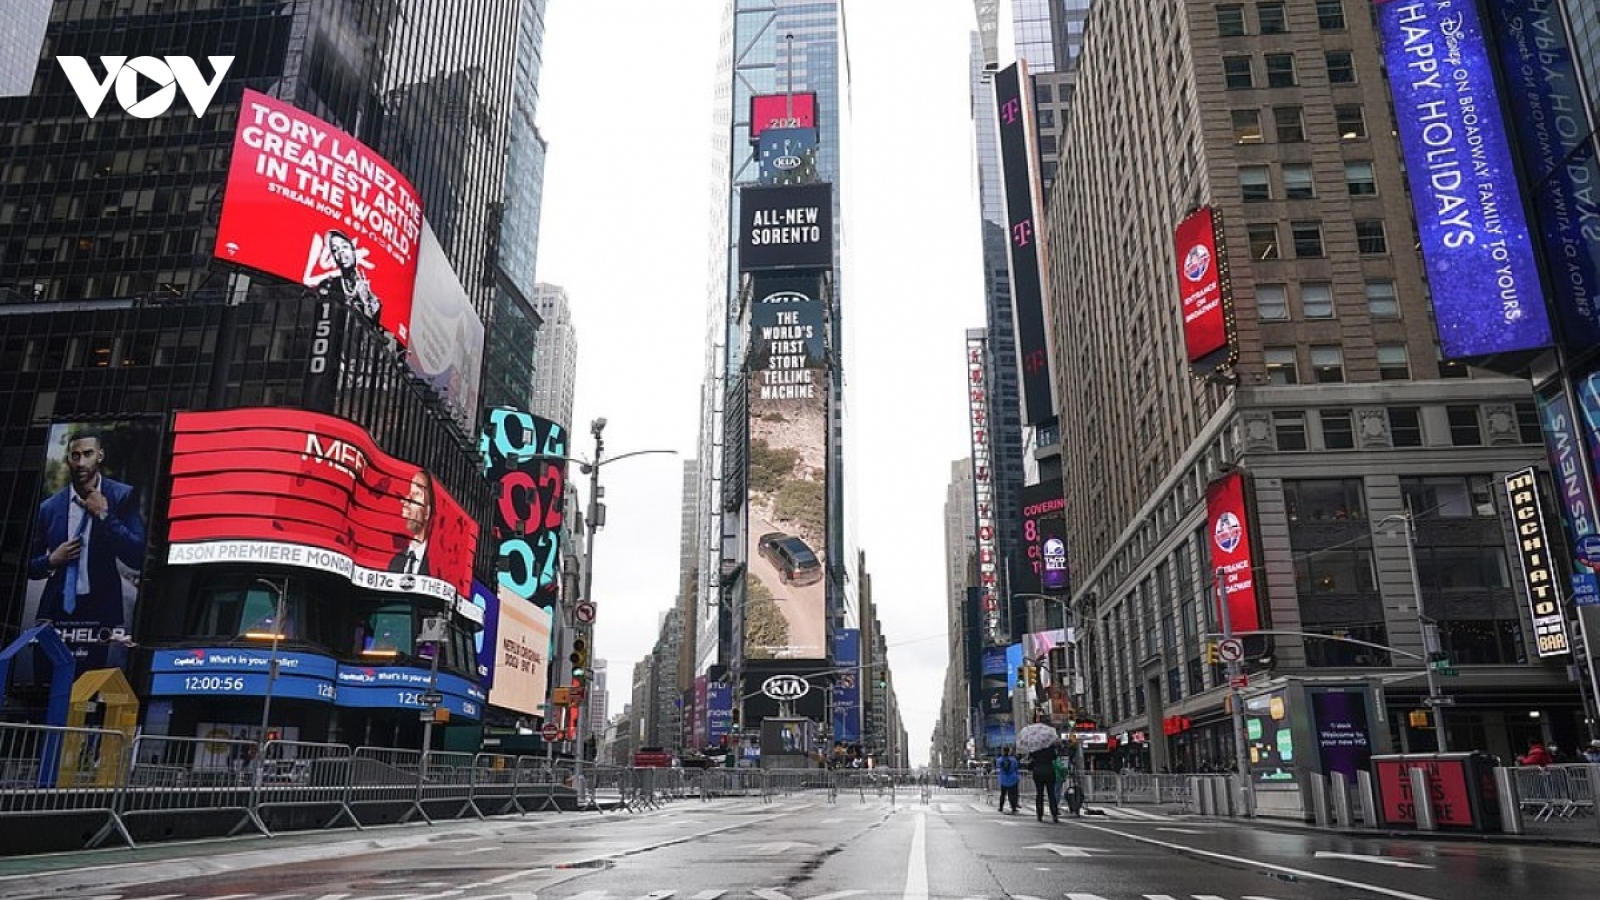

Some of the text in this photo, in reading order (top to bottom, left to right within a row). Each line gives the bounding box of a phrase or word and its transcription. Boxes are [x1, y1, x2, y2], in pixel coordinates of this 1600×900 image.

[1453, 69, 1472, 92] ON
[1397, 3, 1475, 248] HAPPY HOLIDAYS
[1459, 96, 1489, 178] BROADWAY
[252, 103, 421, 224] TORY LANEZ THE
[242, 127, 420, 245] GREATEST ARTIST
[256, 154, 289, 183] IN
[295, 168, 345, 208] THE
[268, 182, 342, 220] STREAM NOW
[1478, 182, 1502, 235] FAMILY
[753, 207, 819, 227] ALL-NEW
[752, 226, 820, 245] SORENTO
[1490, 239, 1508, 260] TO
[776, 311, 799, 324] THE
[310, 303, 331, 373] 1500
[762, 326, 813, 340] WORLD'S
[771, 340, 804, 354] FIRST
[769, 355, 806, 369] STORY
[764, 370, 812, 384] TELLING
[761, 385, 814, 399] MACHINE
[1552, 413, 1581, 497] NEWS
[1507, 473, 1554, 614] MACCHIATO
[218, 544, 301, 561] PREMIERE
[421, 579, 441, 594] THE
[1540, 634, 1565, 651] BAR
[209, 655, 237, 664] What's
[239, 656, 247, 664] in
[249, 657, 268, 666] your
[185, 677, 244, 691] 12:00:56
[770, 680, 800, 695] KIA
[1322, 731, 1354, 739] Welcome
